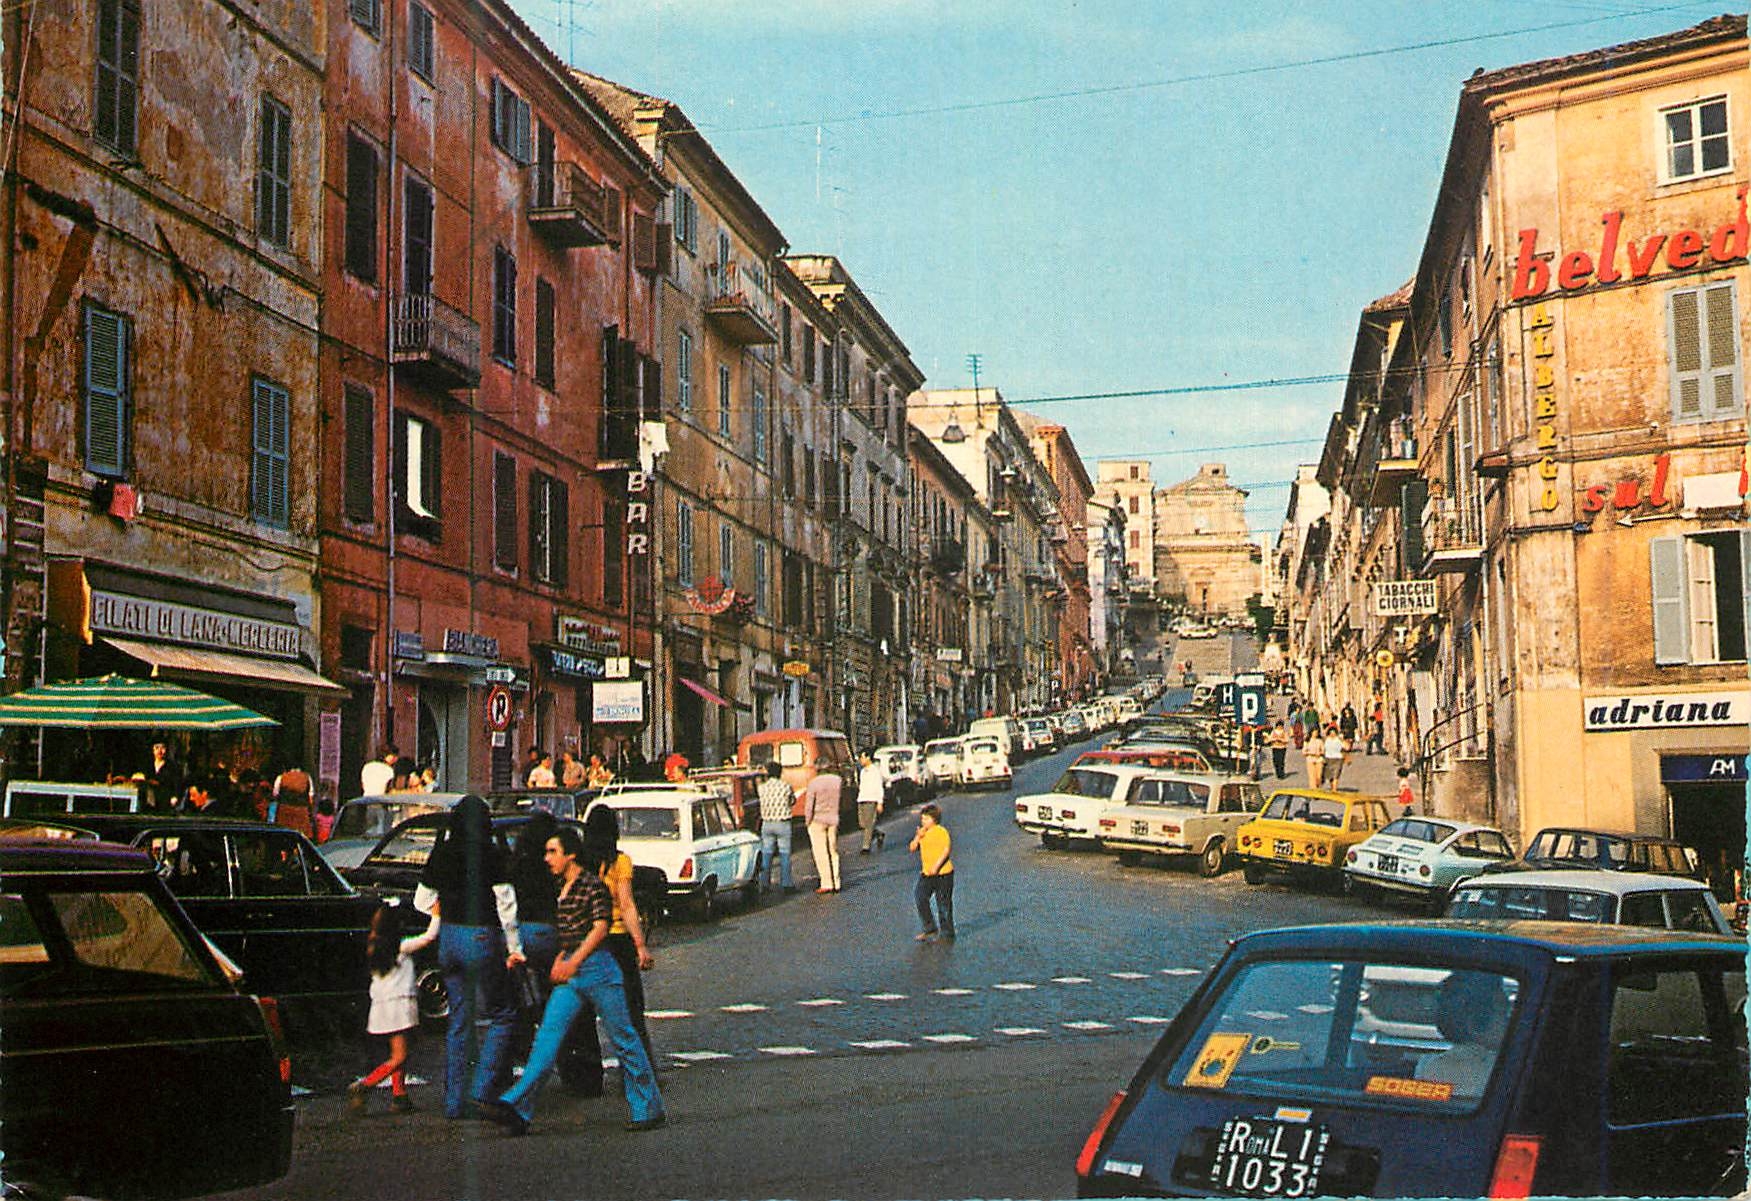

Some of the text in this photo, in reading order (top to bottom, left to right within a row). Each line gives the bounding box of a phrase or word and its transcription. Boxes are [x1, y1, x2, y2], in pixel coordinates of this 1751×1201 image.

[1531, 304, 1559, 512] ALBERGO
[1584, 452, 1671, 512] sul
[627, 471, 648, 555] BAR
[1377, 582, 1434, 596] TABACCHI
[92, 595, 149, 631] FILATI
[1222, 685, 1234, 704] H
[1241, 693, 1258, 723] P
[1588, 698, 1731, 725] adriana
[1710, 758, 1735, 775] AM
[1226, 1153, 1309, 1197] 1033
